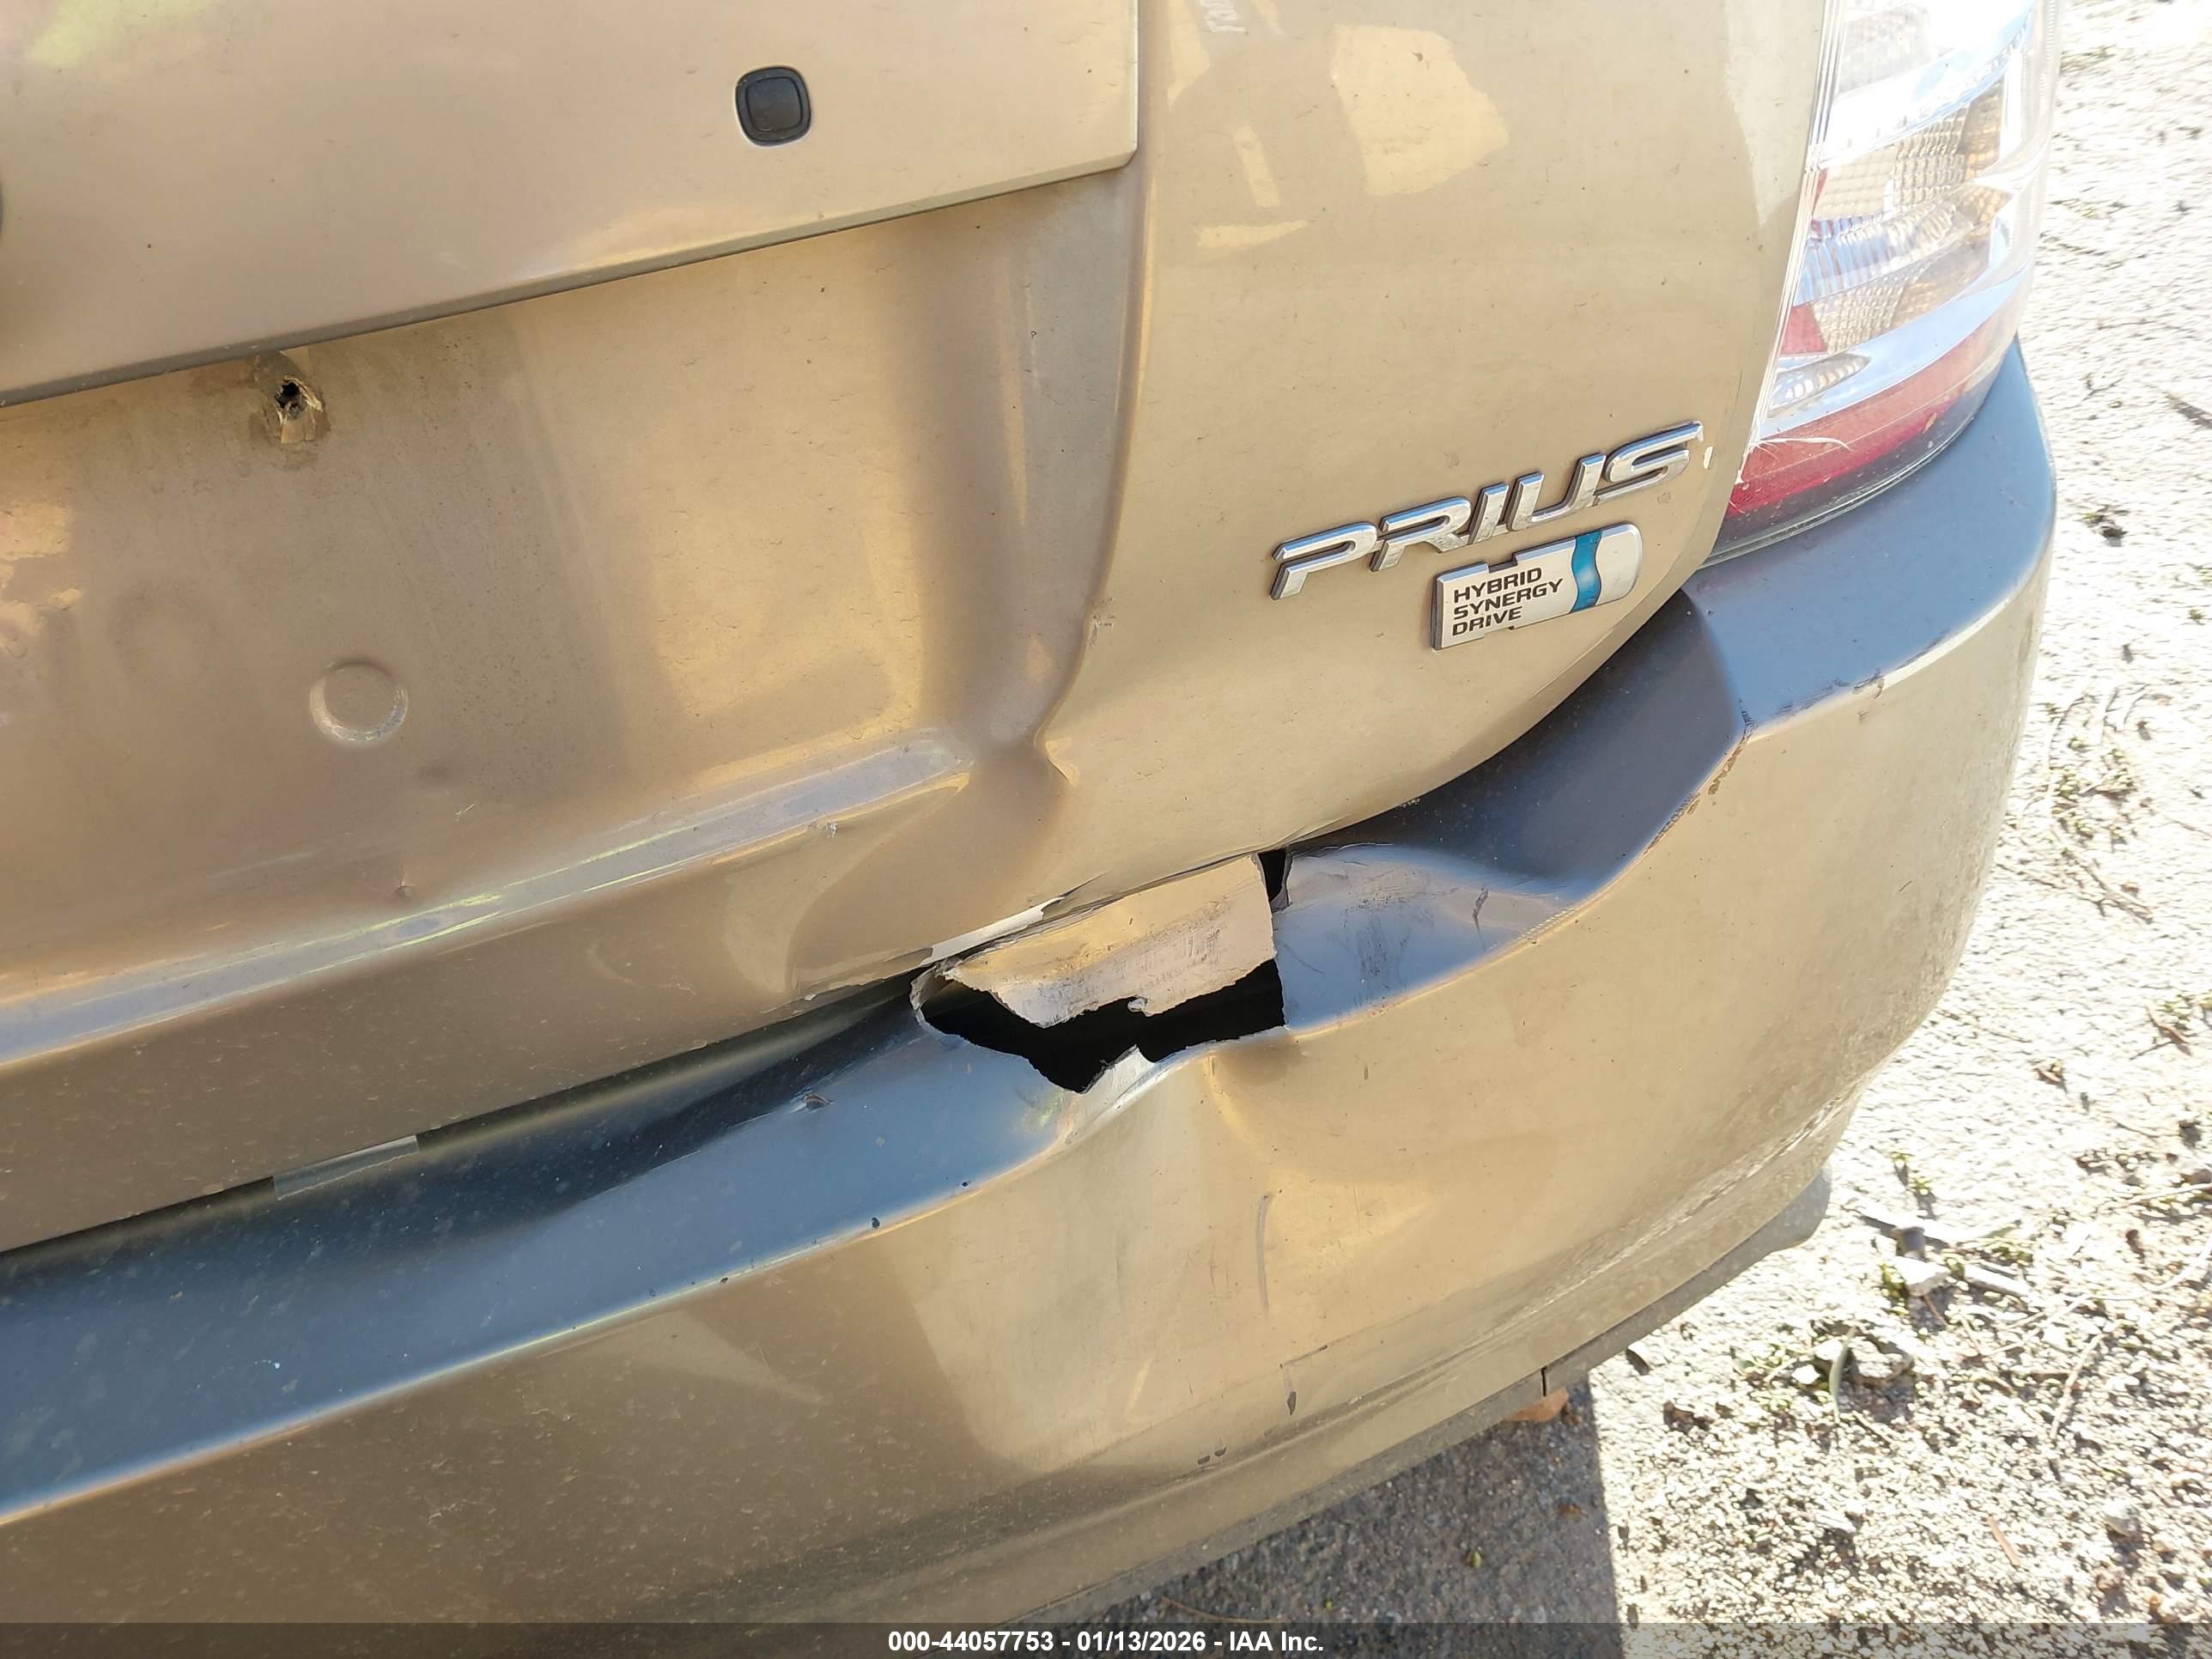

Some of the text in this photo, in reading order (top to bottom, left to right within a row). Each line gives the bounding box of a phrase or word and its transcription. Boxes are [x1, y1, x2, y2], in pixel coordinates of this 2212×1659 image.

[1271, 421, 1704, 600] PRIUS
[1453, 578, 1564, 620] SYNERGY
[1454, 567, 1542, 603] HYBRID
[1452, 605, 1523, 636] DRIVE
